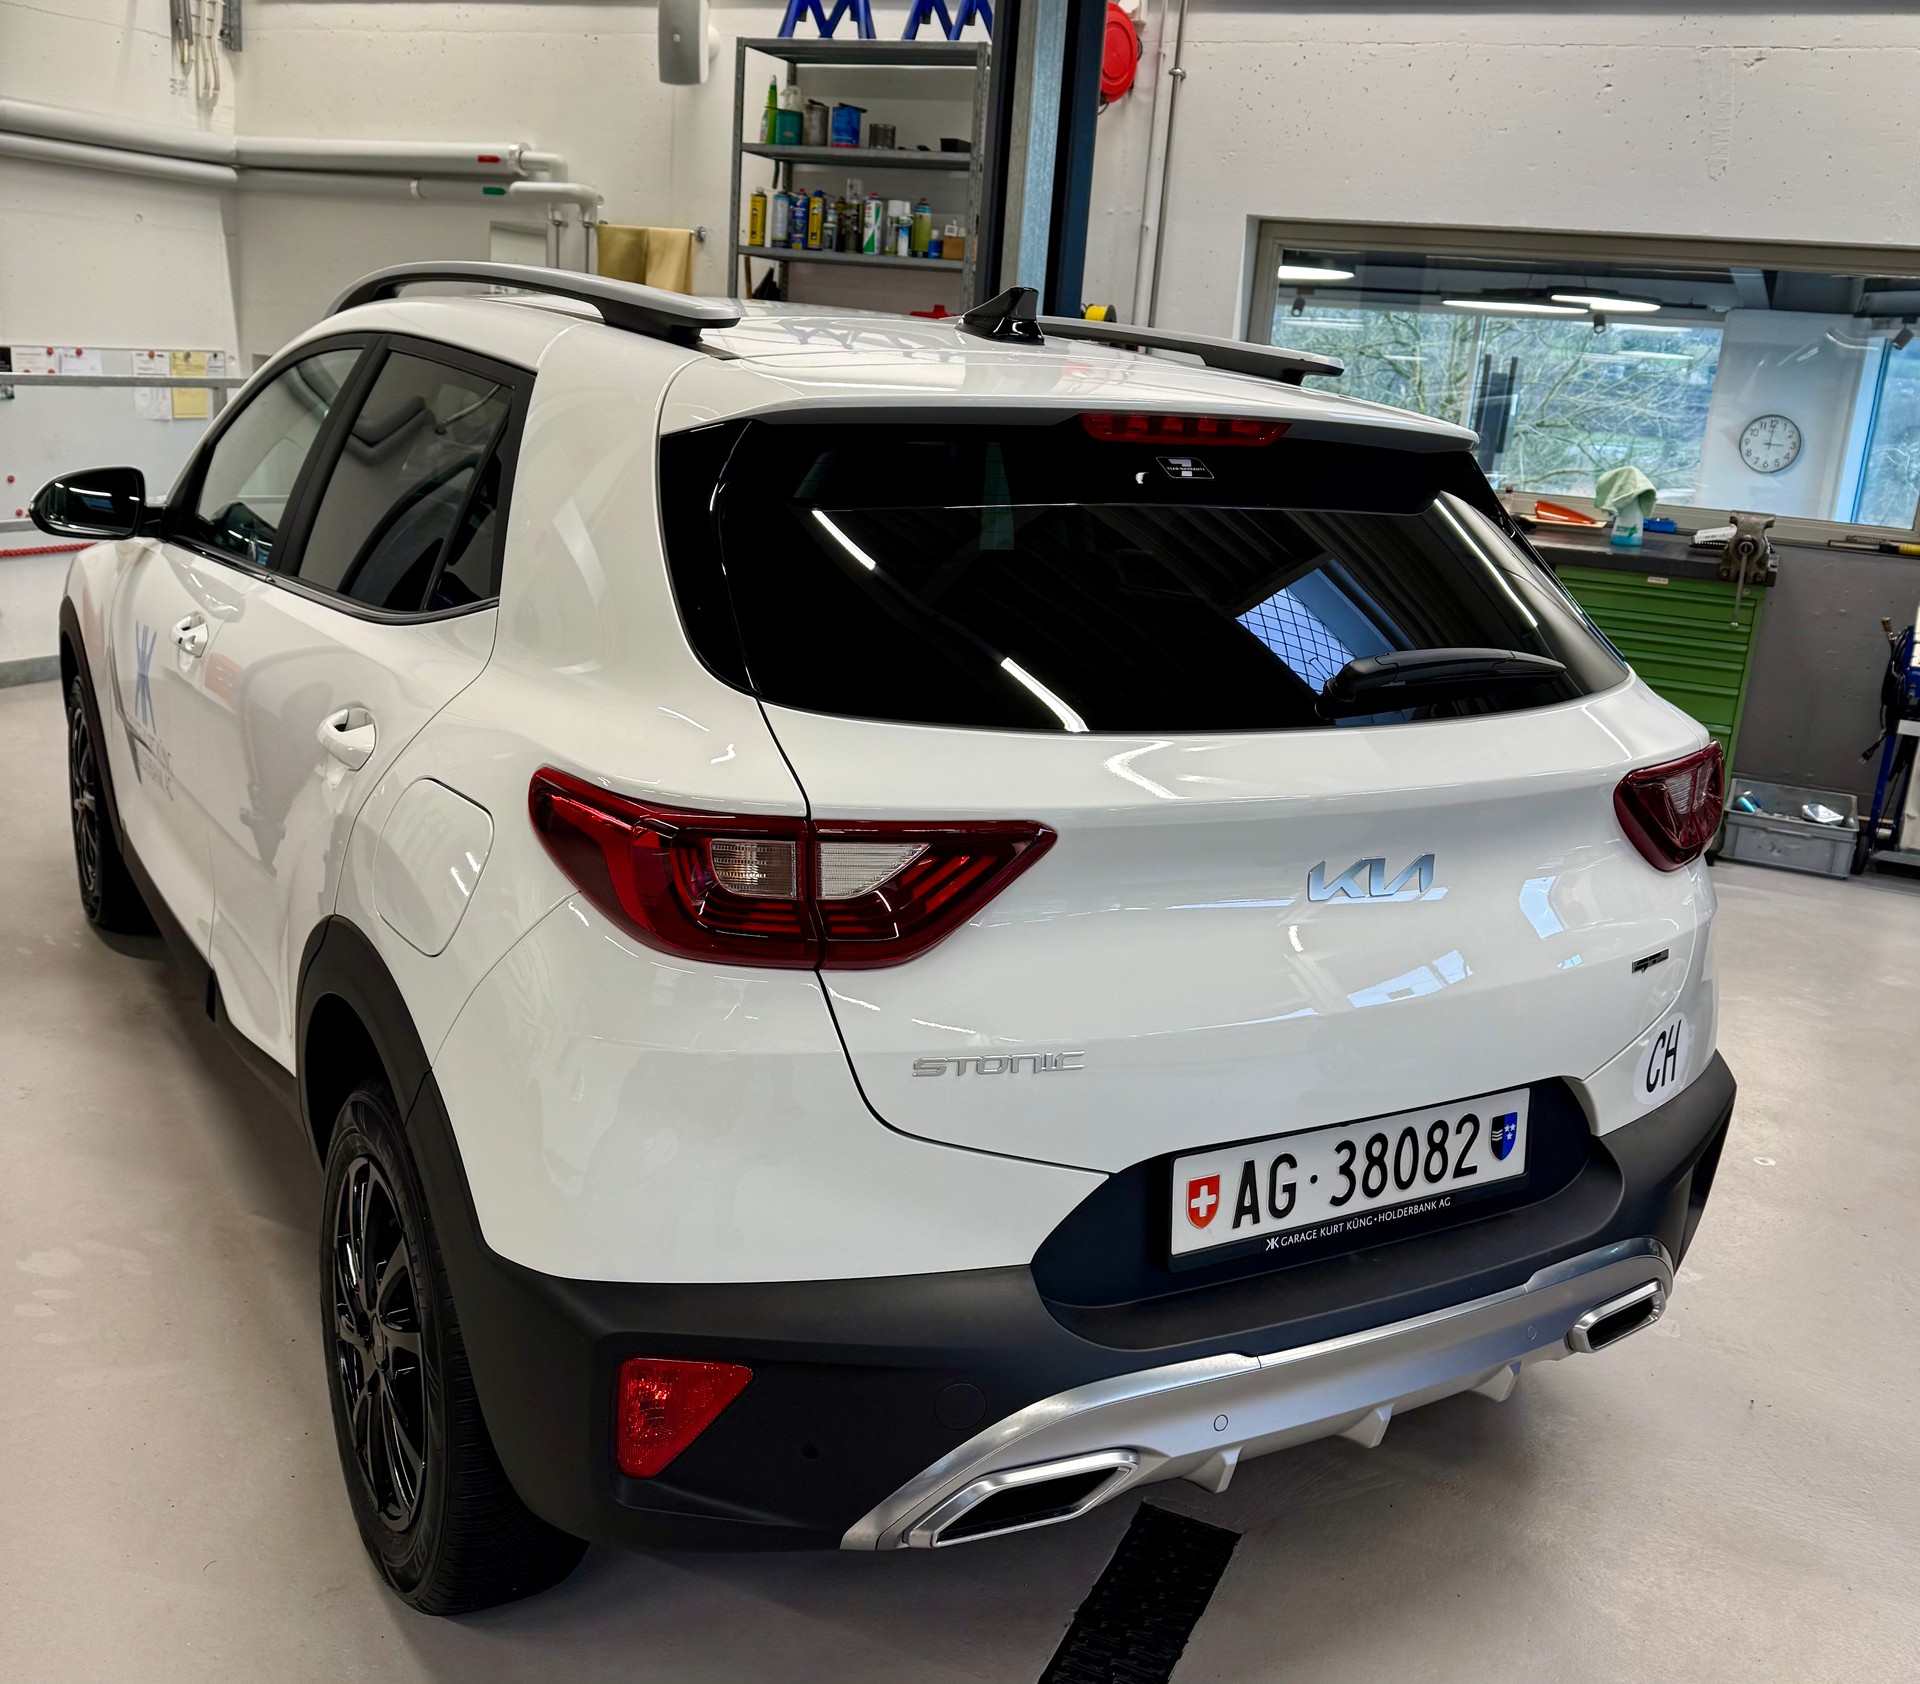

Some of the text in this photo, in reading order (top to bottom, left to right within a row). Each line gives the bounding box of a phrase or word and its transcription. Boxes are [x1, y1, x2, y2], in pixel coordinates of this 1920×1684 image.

[1750, 427, 1760, 437] 10
[1307, 853, 1436, 902] KIA
[911, 1050, 1085, 1078] STONIC
[1645, 1019, 1683, 1089] CH
[1232, 1112, 1481, 1230] AG 38082
[1280, 1229, 1318, 1247] GARAGE
[1320, 1222, 1345, 1237] KURT
[1378, 1200, 1437, 1223] HOLDERBANK
[1438, 1197, 1451, 1209] AG
